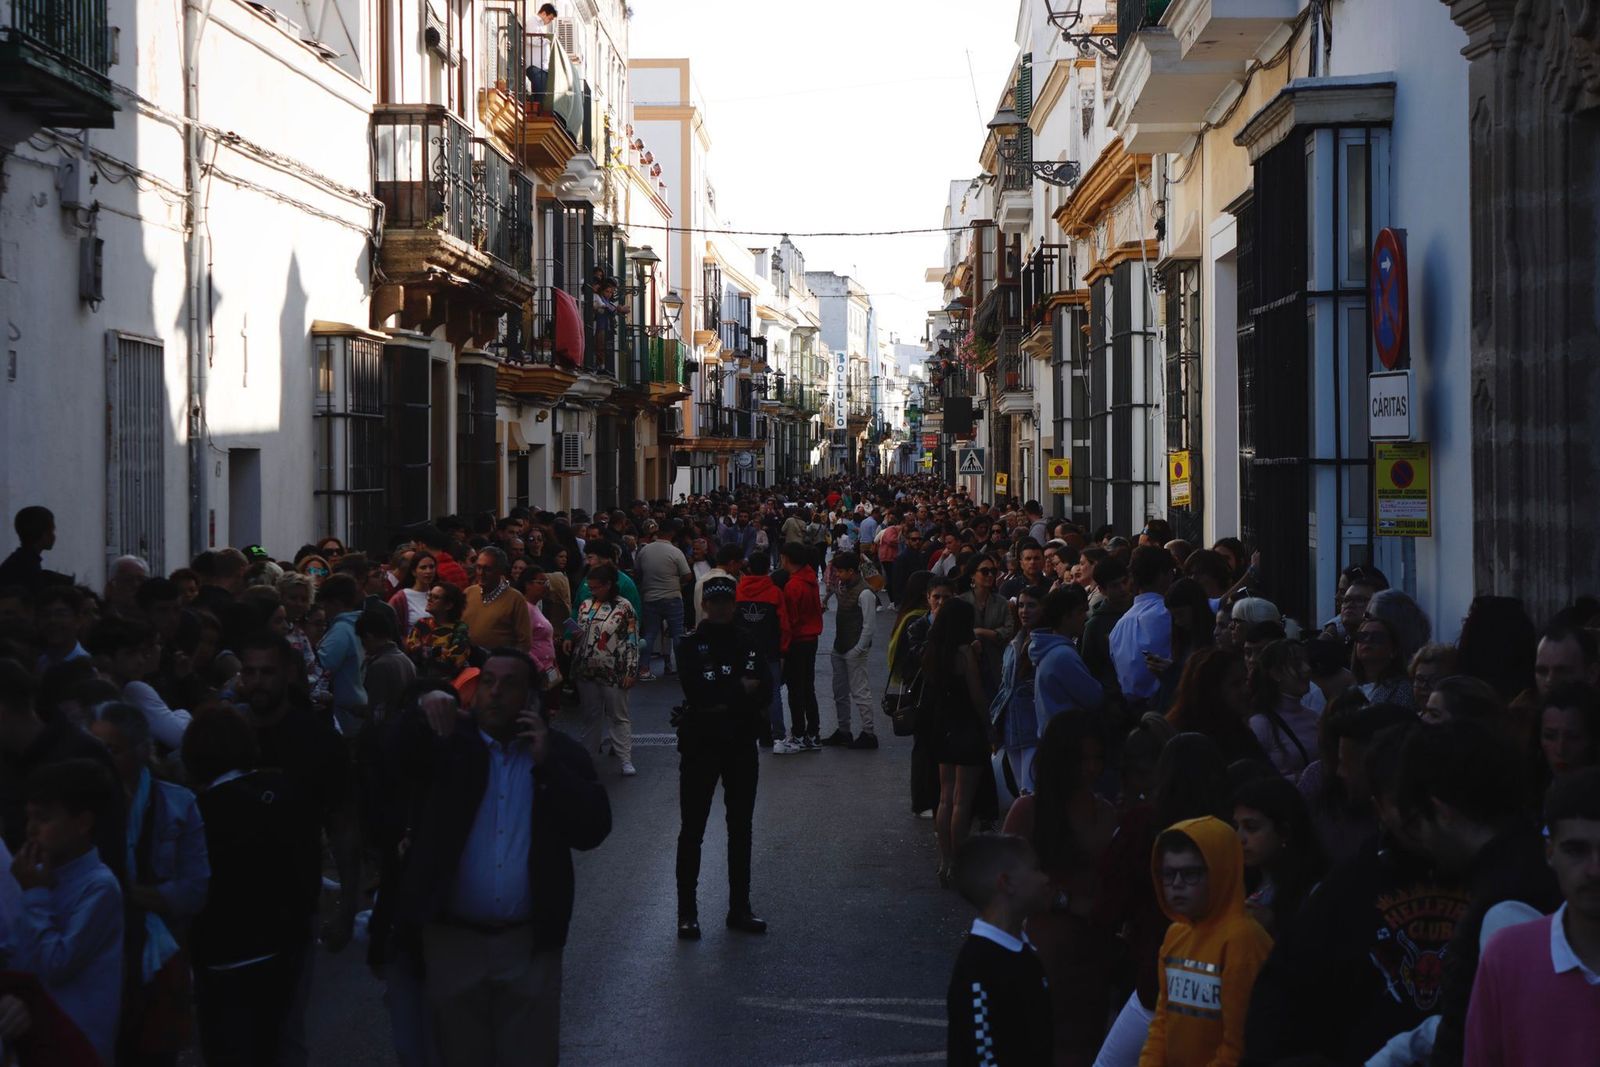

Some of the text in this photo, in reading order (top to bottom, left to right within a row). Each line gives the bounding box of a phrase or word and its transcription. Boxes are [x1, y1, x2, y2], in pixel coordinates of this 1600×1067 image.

[836, 353, 846, 427] BOLLULLO
[1372, 392, 1407, 418] CÁRITAS
[1408, 918, 1455, 941] CLUB
